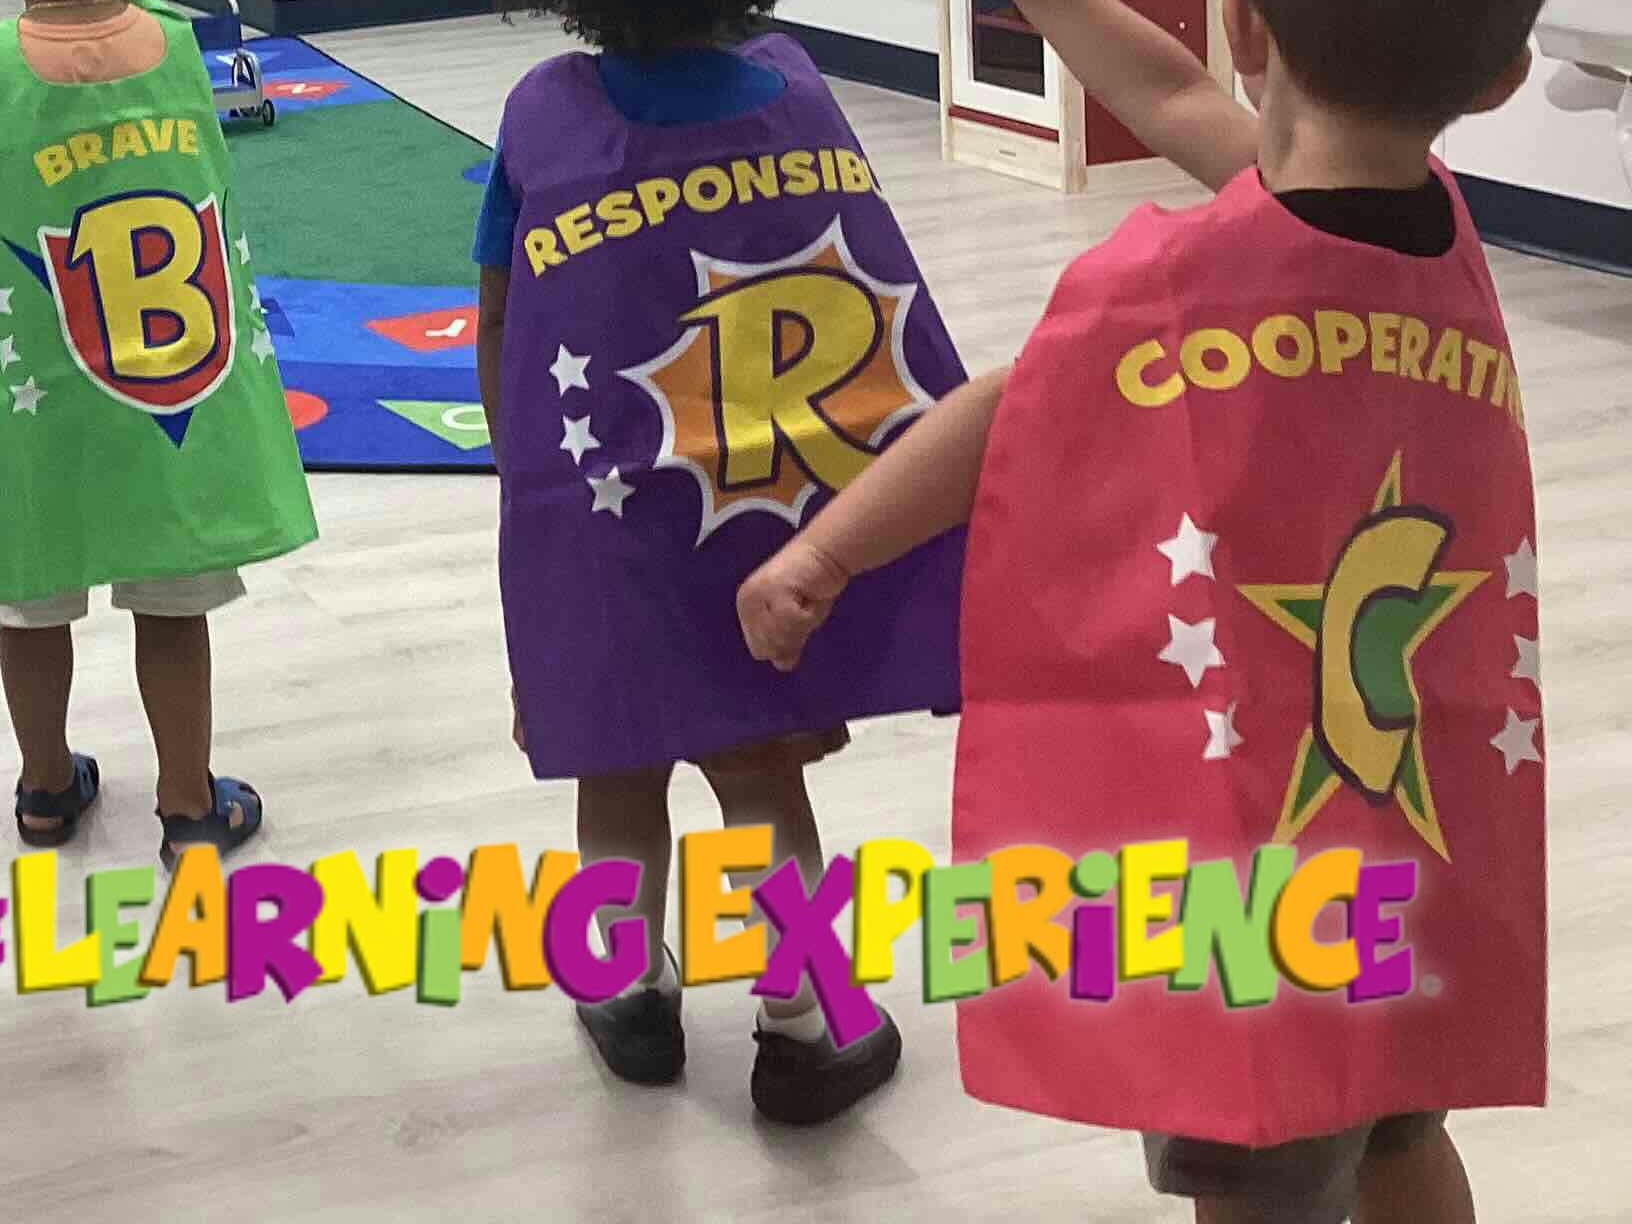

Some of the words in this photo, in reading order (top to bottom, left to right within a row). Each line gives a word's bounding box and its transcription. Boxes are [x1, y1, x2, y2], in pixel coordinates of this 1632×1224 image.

[33, 119, 200, 186] BRAVE
[68, 189, 220, 384] B
[678, 265, 883, 496] R
[1313, 504, 1453, 807] C
